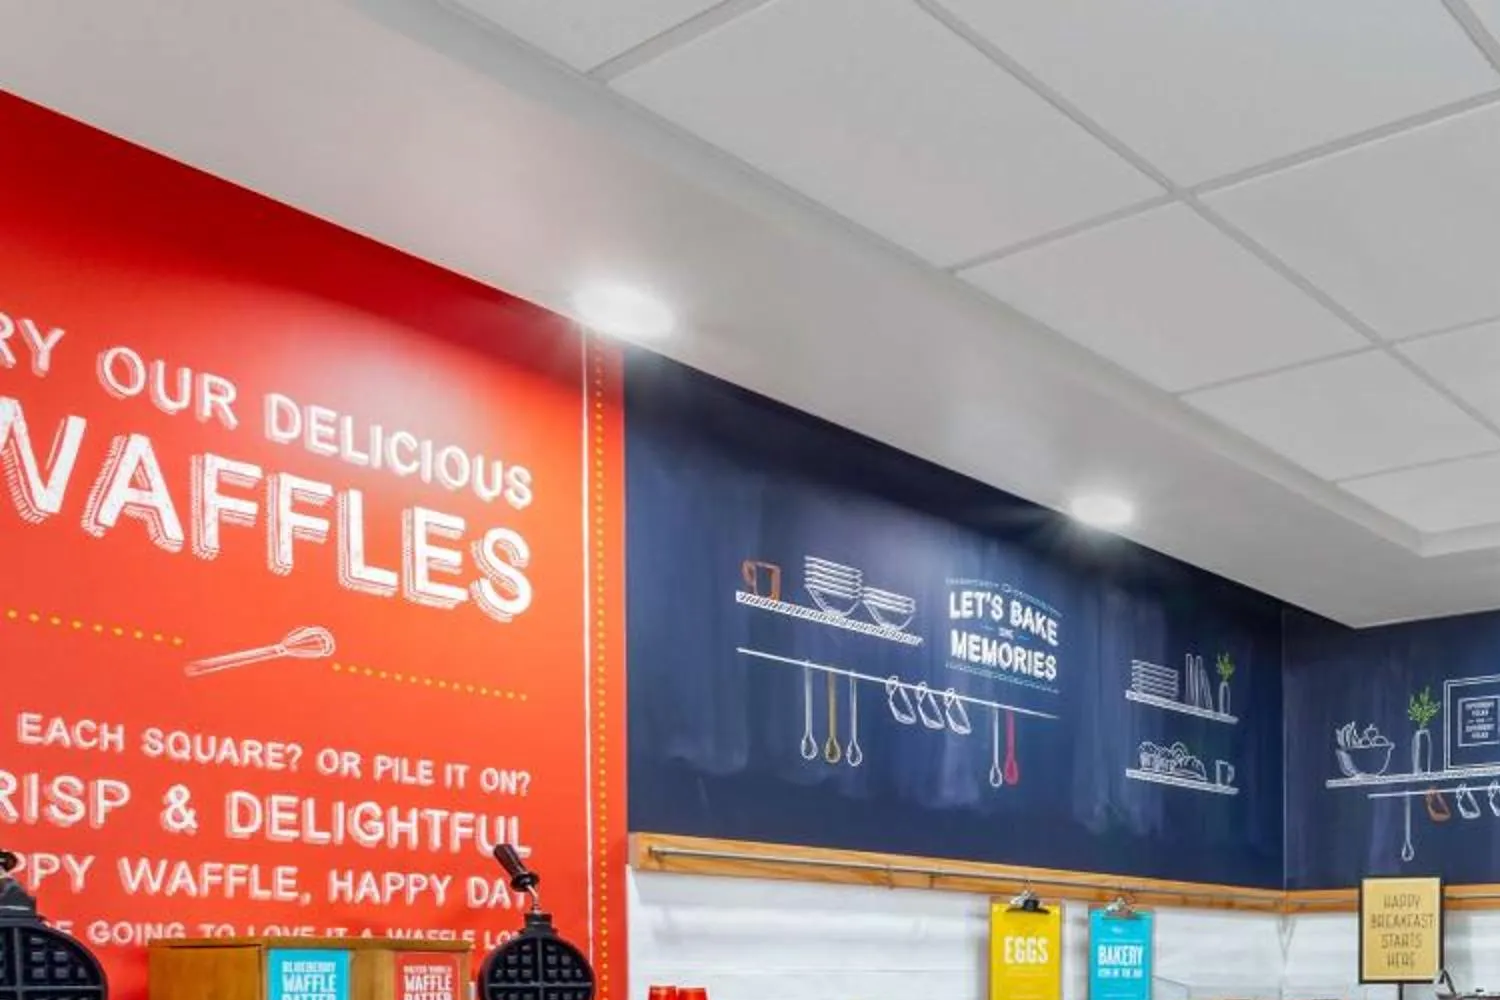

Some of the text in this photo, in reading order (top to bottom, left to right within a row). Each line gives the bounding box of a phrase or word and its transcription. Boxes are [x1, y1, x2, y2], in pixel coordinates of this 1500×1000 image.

[95, 345, 239, 429] OUR
[263, 392, 534, 509] DELICIOUS
[949, 591, 1060, 646] LET'S BAKE
[950, 629, 1058, 681] MEMORIES
[17, 712, 532, 798] EACH SQUARE? OR PILE IT ON?
[161, 781, 199, 835] &
[224, 790, 532, 859] DELIGHTFUL
[118, 854, 312, 905] WAFFLE,
[328, 868, 454, 909] HAPPY
[1382, 893, 1422, 909] HAPPY
[87, 919, 187, 947] GOING
[197, 922, 236, 939] TO
[1370, 913, 1434, 929] BREAKFAST
[1003, 936, 1049, 965] EGGS
[1380, 932, 1423, 949] STARTS
[1097, 944, 1144, 966] BAKERY
[1386, 952, 1417, 969] HERE
[281, 973, 337, 993] WAFFLE
[403, 973, 454, 992] WAFFLE
